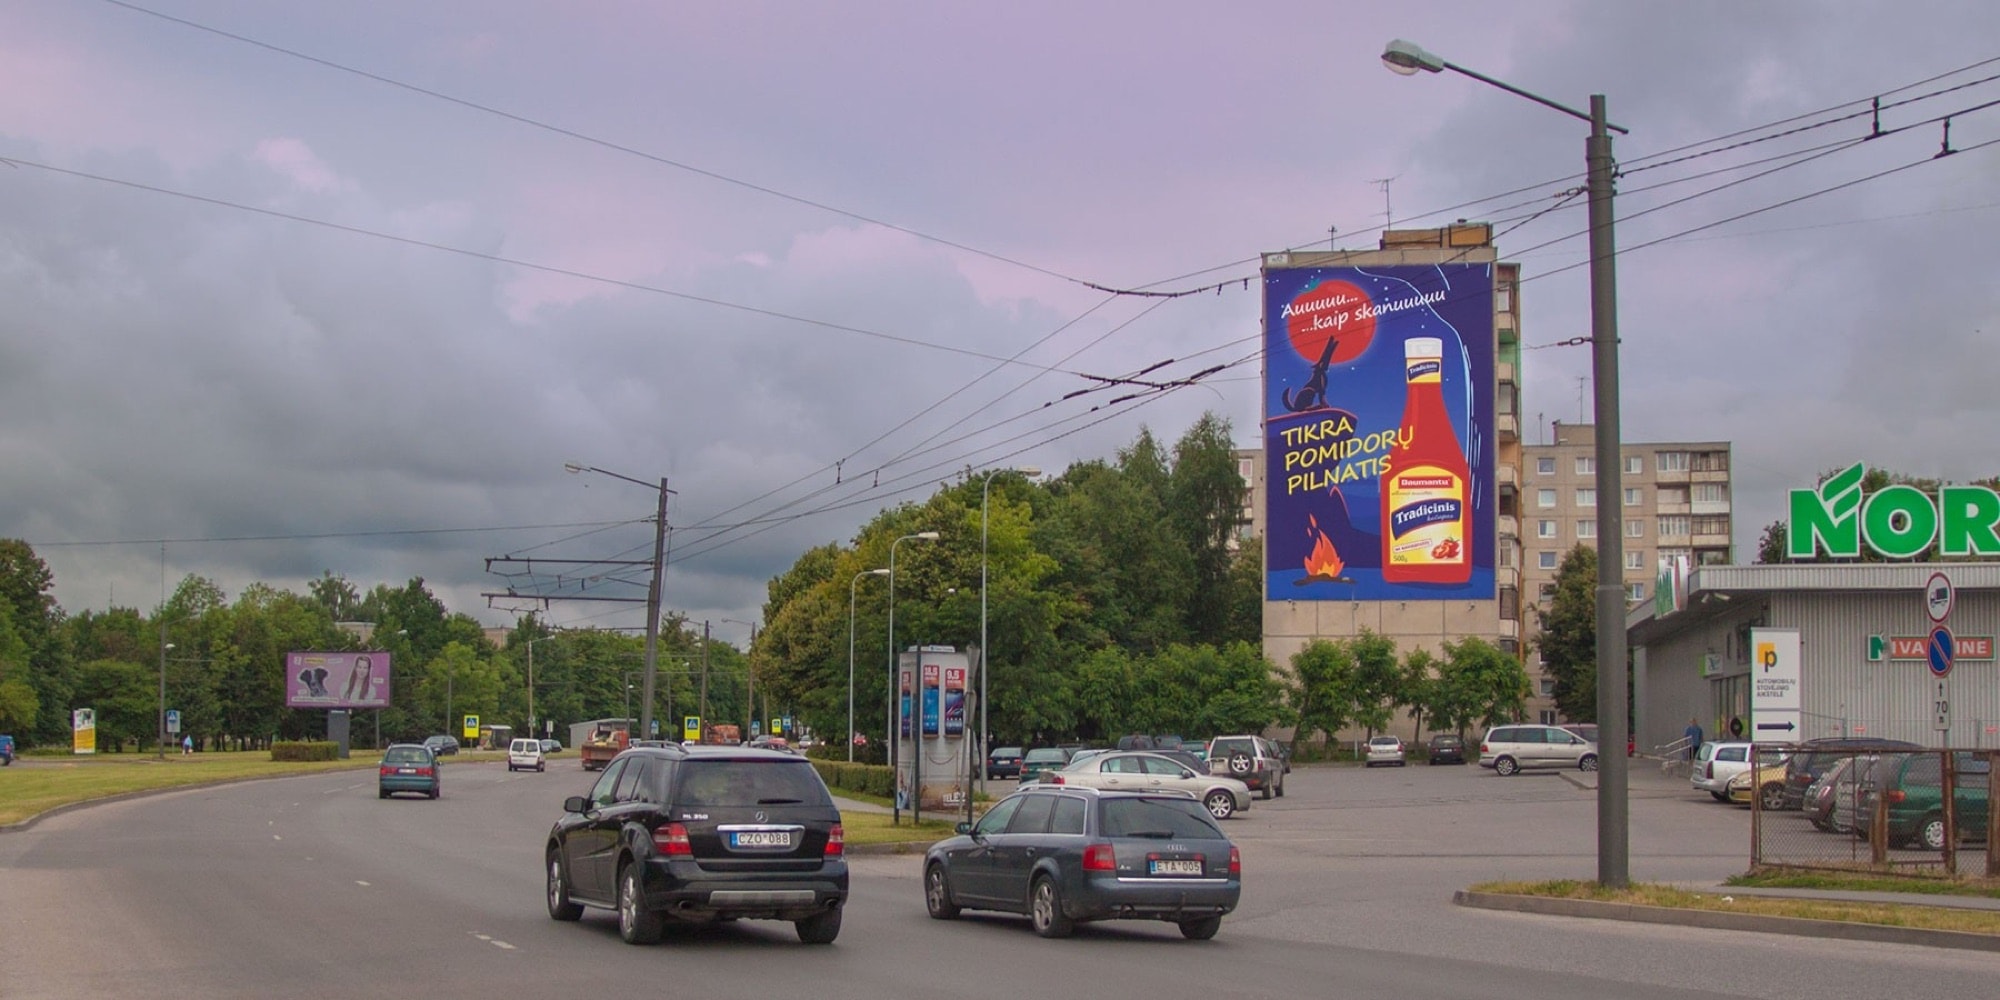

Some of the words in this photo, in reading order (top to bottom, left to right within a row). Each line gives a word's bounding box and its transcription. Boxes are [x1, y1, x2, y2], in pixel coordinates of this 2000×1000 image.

[1280, 416, 1354, 448] TIKRA
[1284, 425, 1414, 472] POMIDORŲ
[1287, 453, 1392, 495] PILNATIS
[1395, 502, 1456, 525] Tradicinis
[1787, 461, 2000, 558] NOR
[1935, 701, 1948, 713] 70
